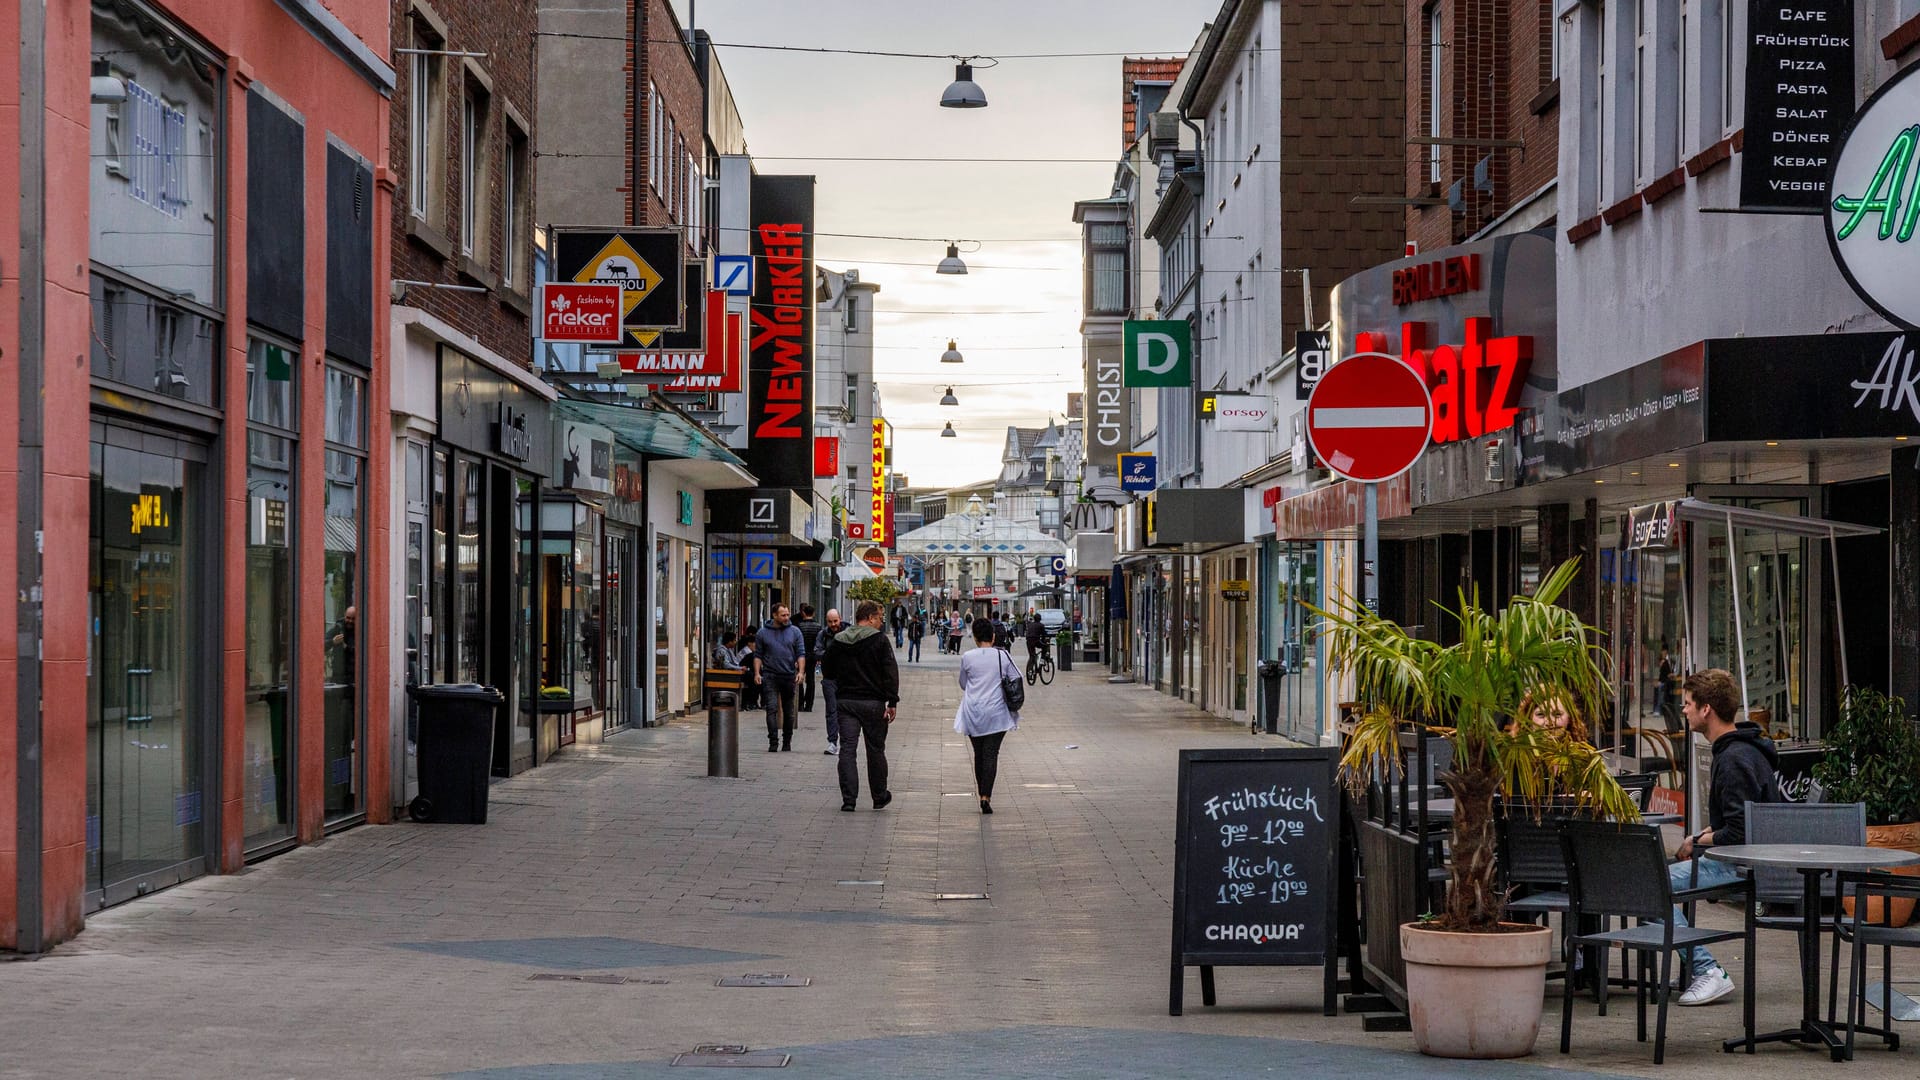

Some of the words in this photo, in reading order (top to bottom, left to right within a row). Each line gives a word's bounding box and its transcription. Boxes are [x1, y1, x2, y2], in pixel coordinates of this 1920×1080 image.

[1780, 9, 1827, 21] CAFE
[1756, 33, 1850, 47] FRÜHSTÜCK
[1780, 59, 1826, 70] PIZZA
[1777, 84, 1828, 95] PASTA
[1776, 108, 1828, 119] SALAT
[1772, 131, 1830, 143] DÖNER
[1773, 156, 1827, 167] KEBAP
[1392, 253, 1480, 306] BRILLEN
[577, 294, 603, 305] fashion
[606, 295, 615, 308] by
[548, 308, 612, 325] rieker
[1137, 332, 1179, 374] D
[637, 354, 705, 369] MANN
[669, 375, 722, 387] ANN
[1097, 358, 1120, 446] CHRIST
[1222, 409, 1267, 422] orsay
[1204, 784, 1324, 822] Frühstück
[1222, 855, 1296, 880] Küche
